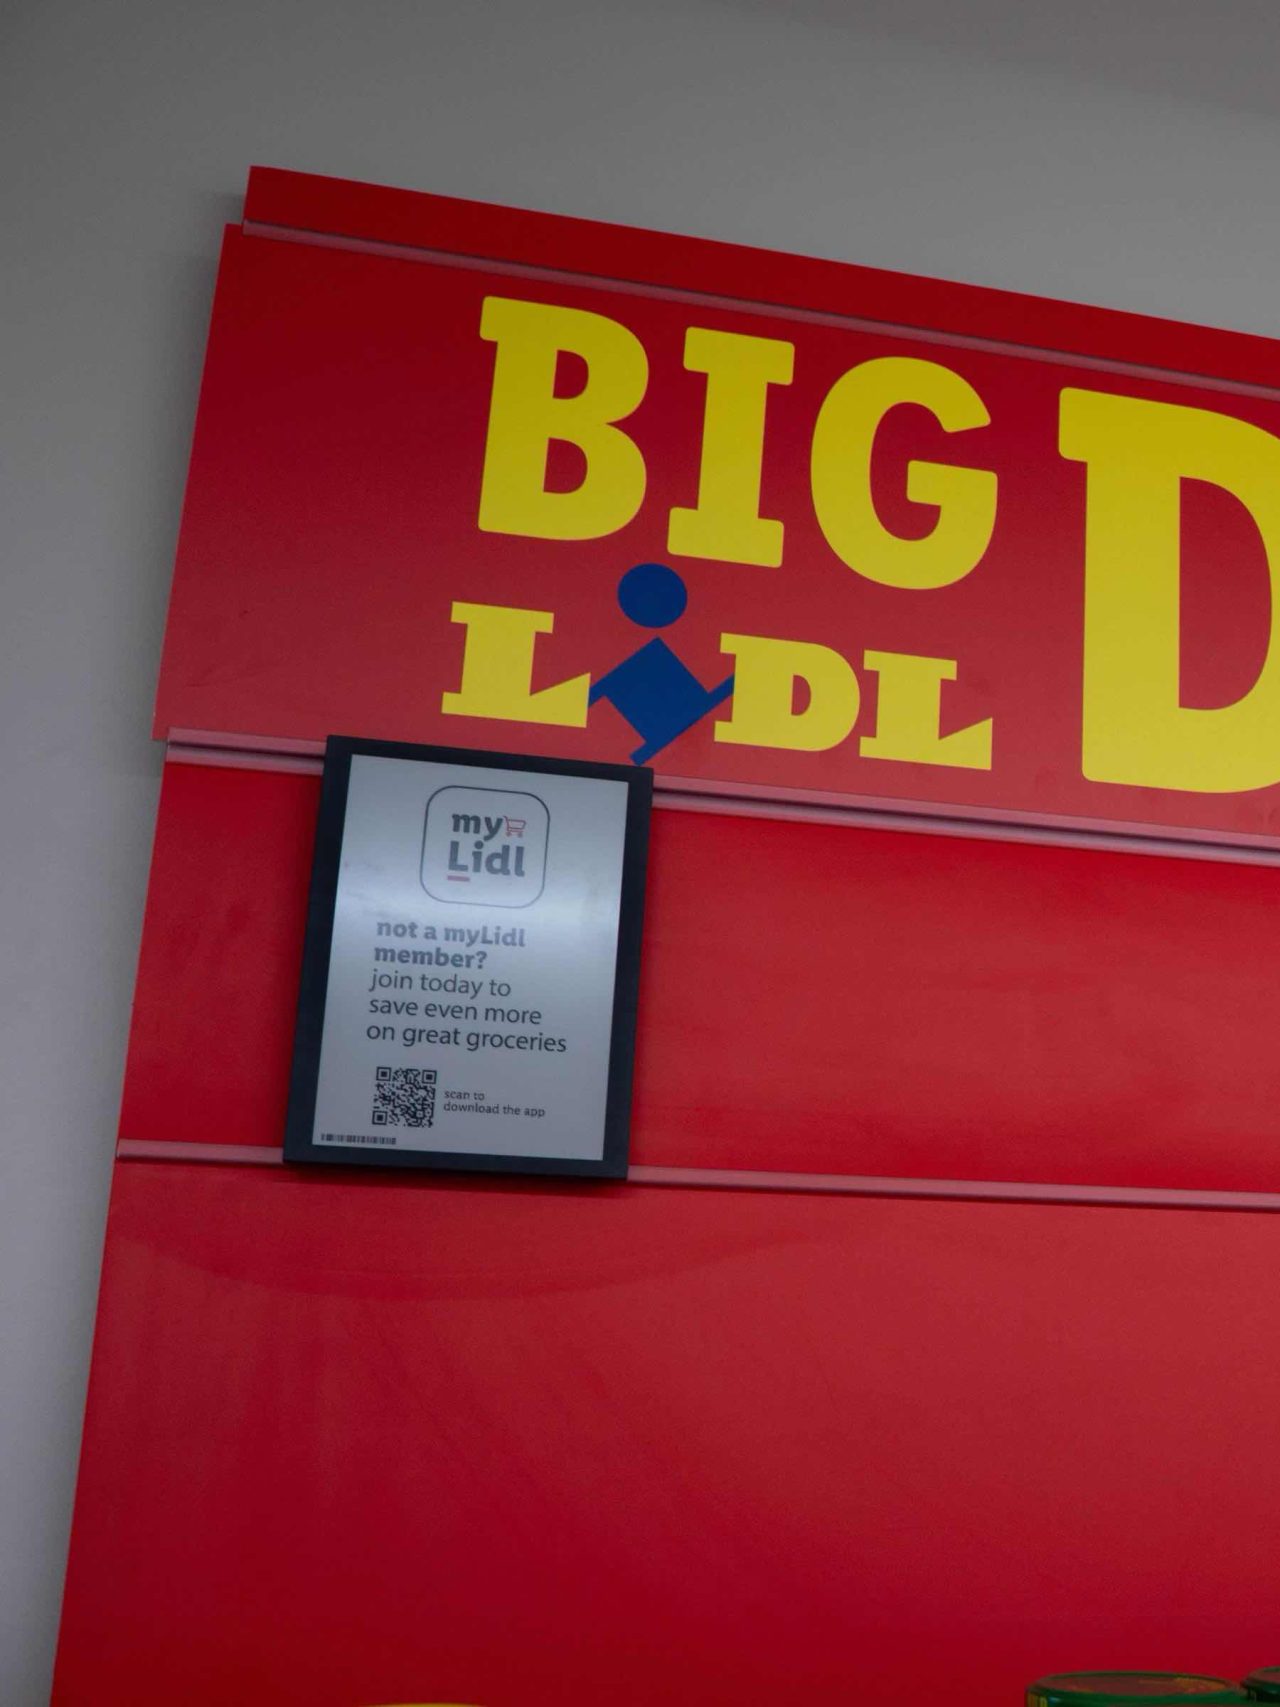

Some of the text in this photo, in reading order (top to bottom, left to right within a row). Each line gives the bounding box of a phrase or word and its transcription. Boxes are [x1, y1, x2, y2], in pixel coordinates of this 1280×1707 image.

[479, 295, 998, 590] BIG
[451, 813, 504, 842] my
[448, 840, 525, 877] Lidl
[376, 921, 527, 948] not a myLidl
[374, 946, 488, 970] member?
[368, 968, 512, 1000] join today to
[368, 998, 542, 1026] save even more
[366, 1024, 568, 1053] on great groceries
[444, 1090, 486, 1101] scan to
[443, 1102, 546, 1118] download the app
